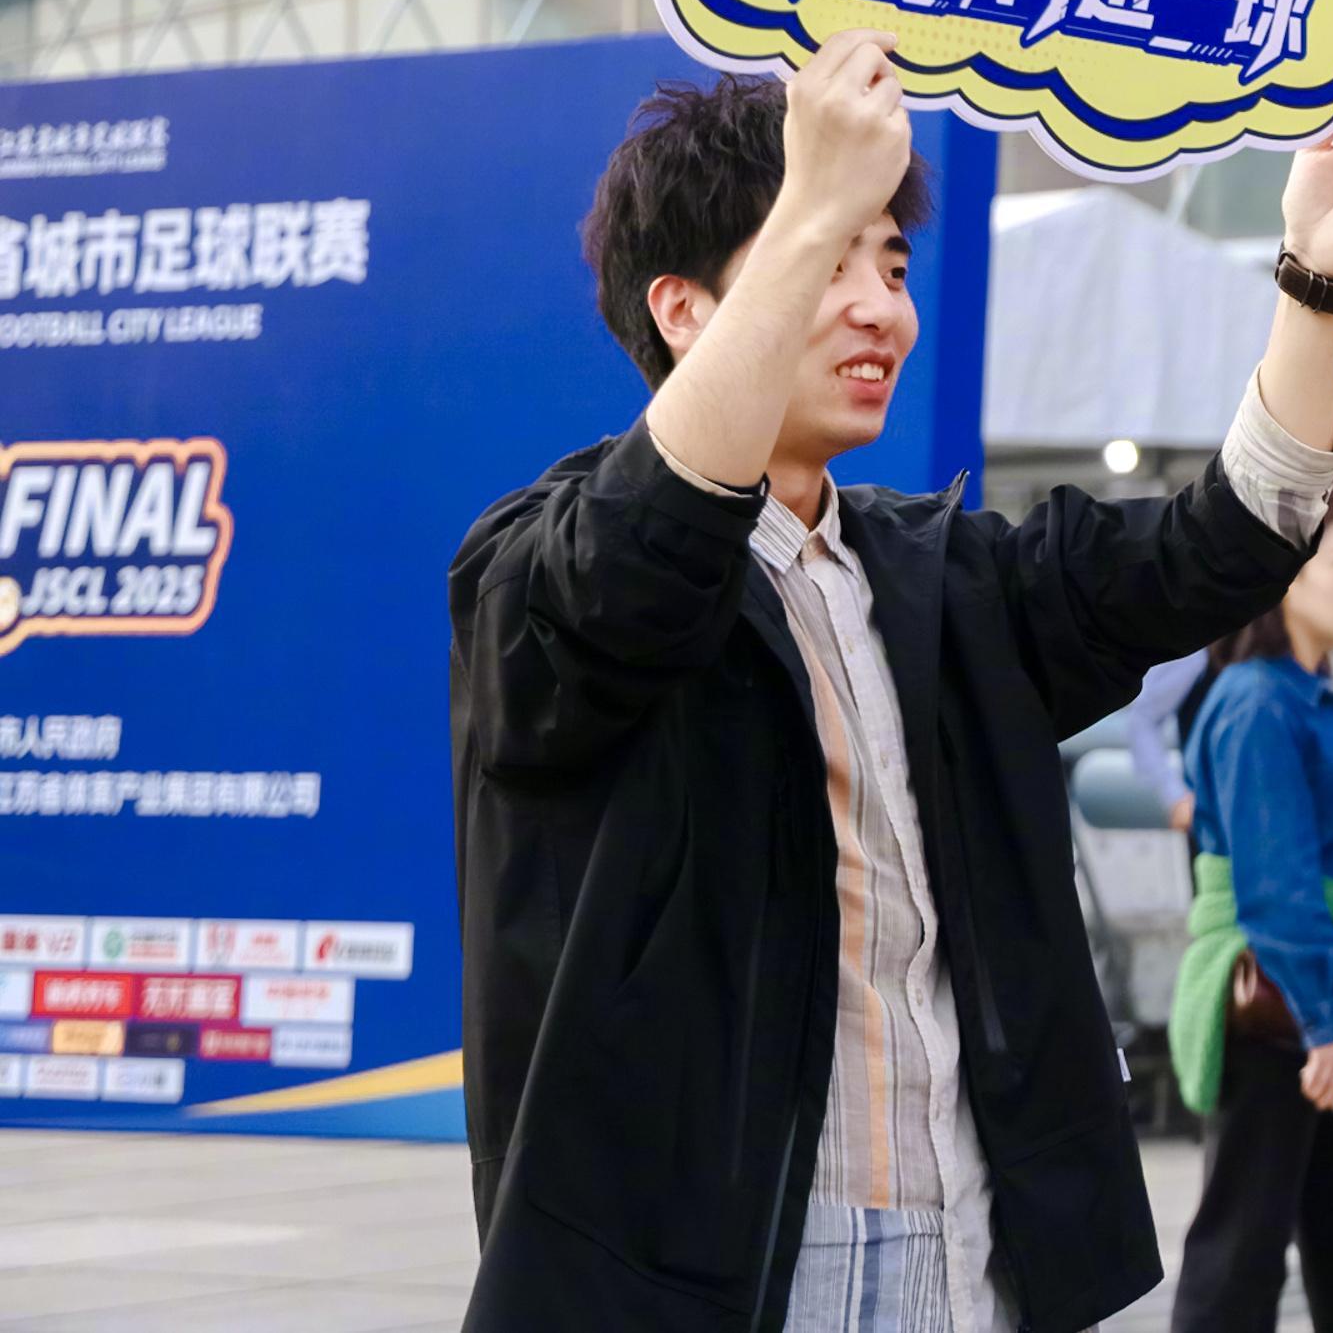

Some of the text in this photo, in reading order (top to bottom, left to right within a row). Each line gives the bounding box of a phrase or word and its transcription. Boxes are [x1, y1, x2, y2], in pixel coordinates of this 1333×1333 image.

[107, 306, 163, 345] CITY
[163, 302, 264, 342] LEAGUE
[0, 461, 218, 558] FINAL
[20, 565, 205, 616] JSCL 2025
